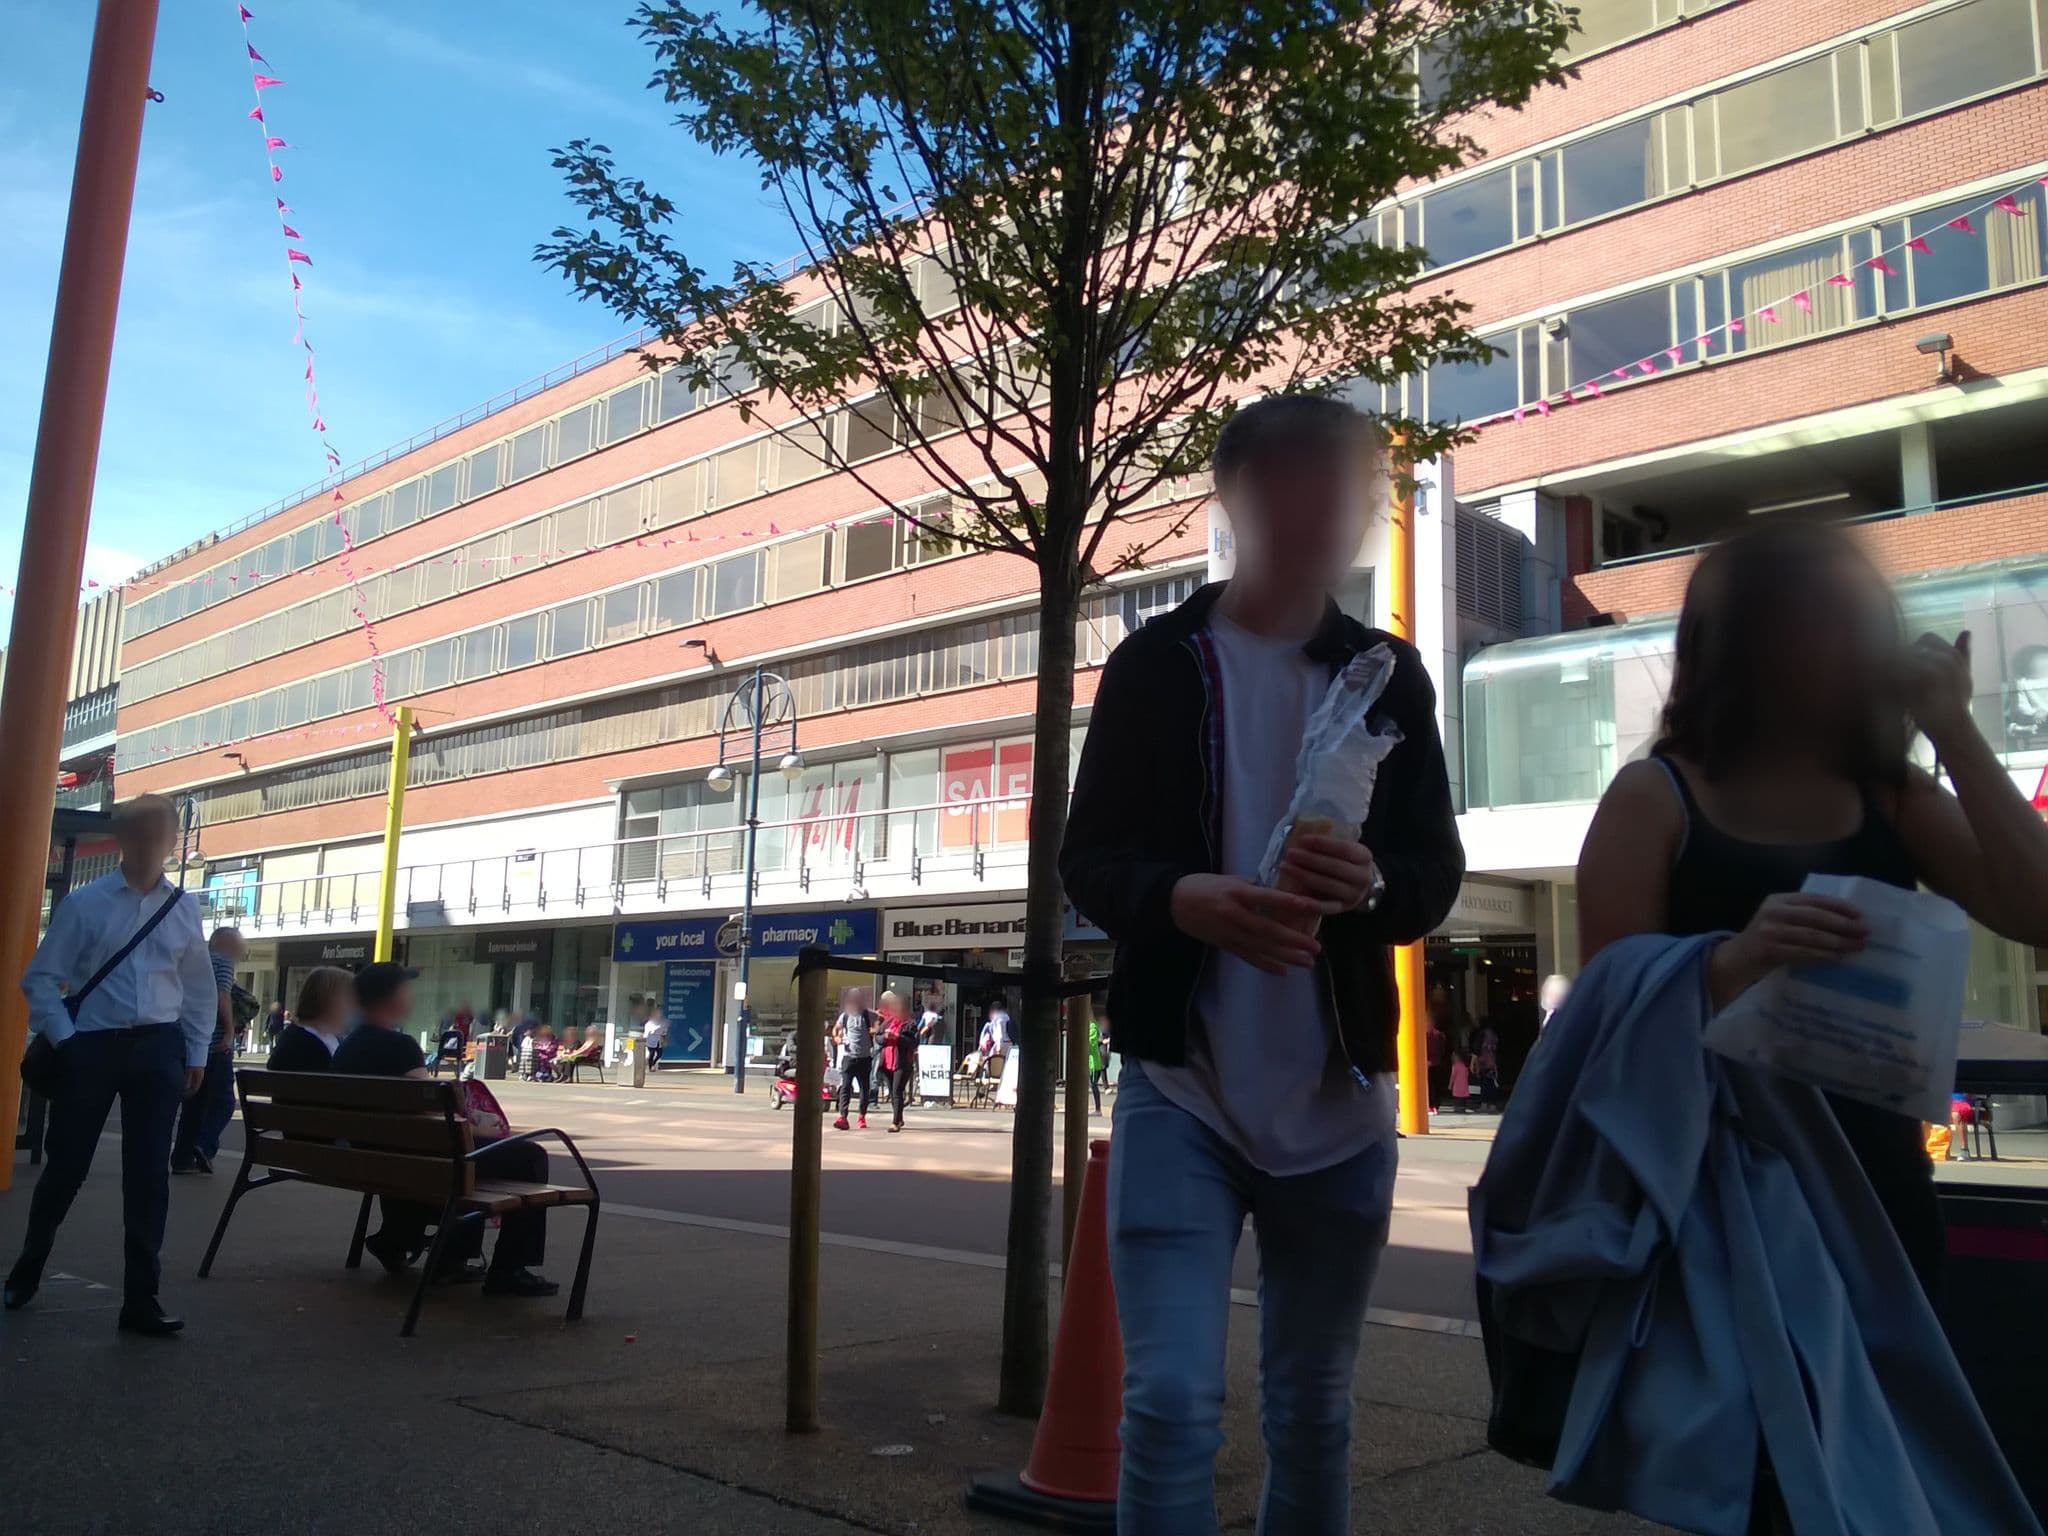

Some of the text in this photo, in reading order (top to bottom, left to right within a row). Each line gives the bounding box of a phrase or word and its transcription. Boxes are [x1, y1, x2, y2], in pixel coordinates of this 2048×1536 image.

[947, 773, 1027, 817] SALE
[790, 776, 862, 852] H&M
[1461, 896, 1513, 913] HAYMARKET
[892, 920, 943, 938] Blue
[655, 934, 678, 950] your
[680, 930, 705, 947] local
[762, 927, 819, 945] pharmacy
[670, 968, 712, 977] welcome
[921, 1069, 952, 1080] NERO
